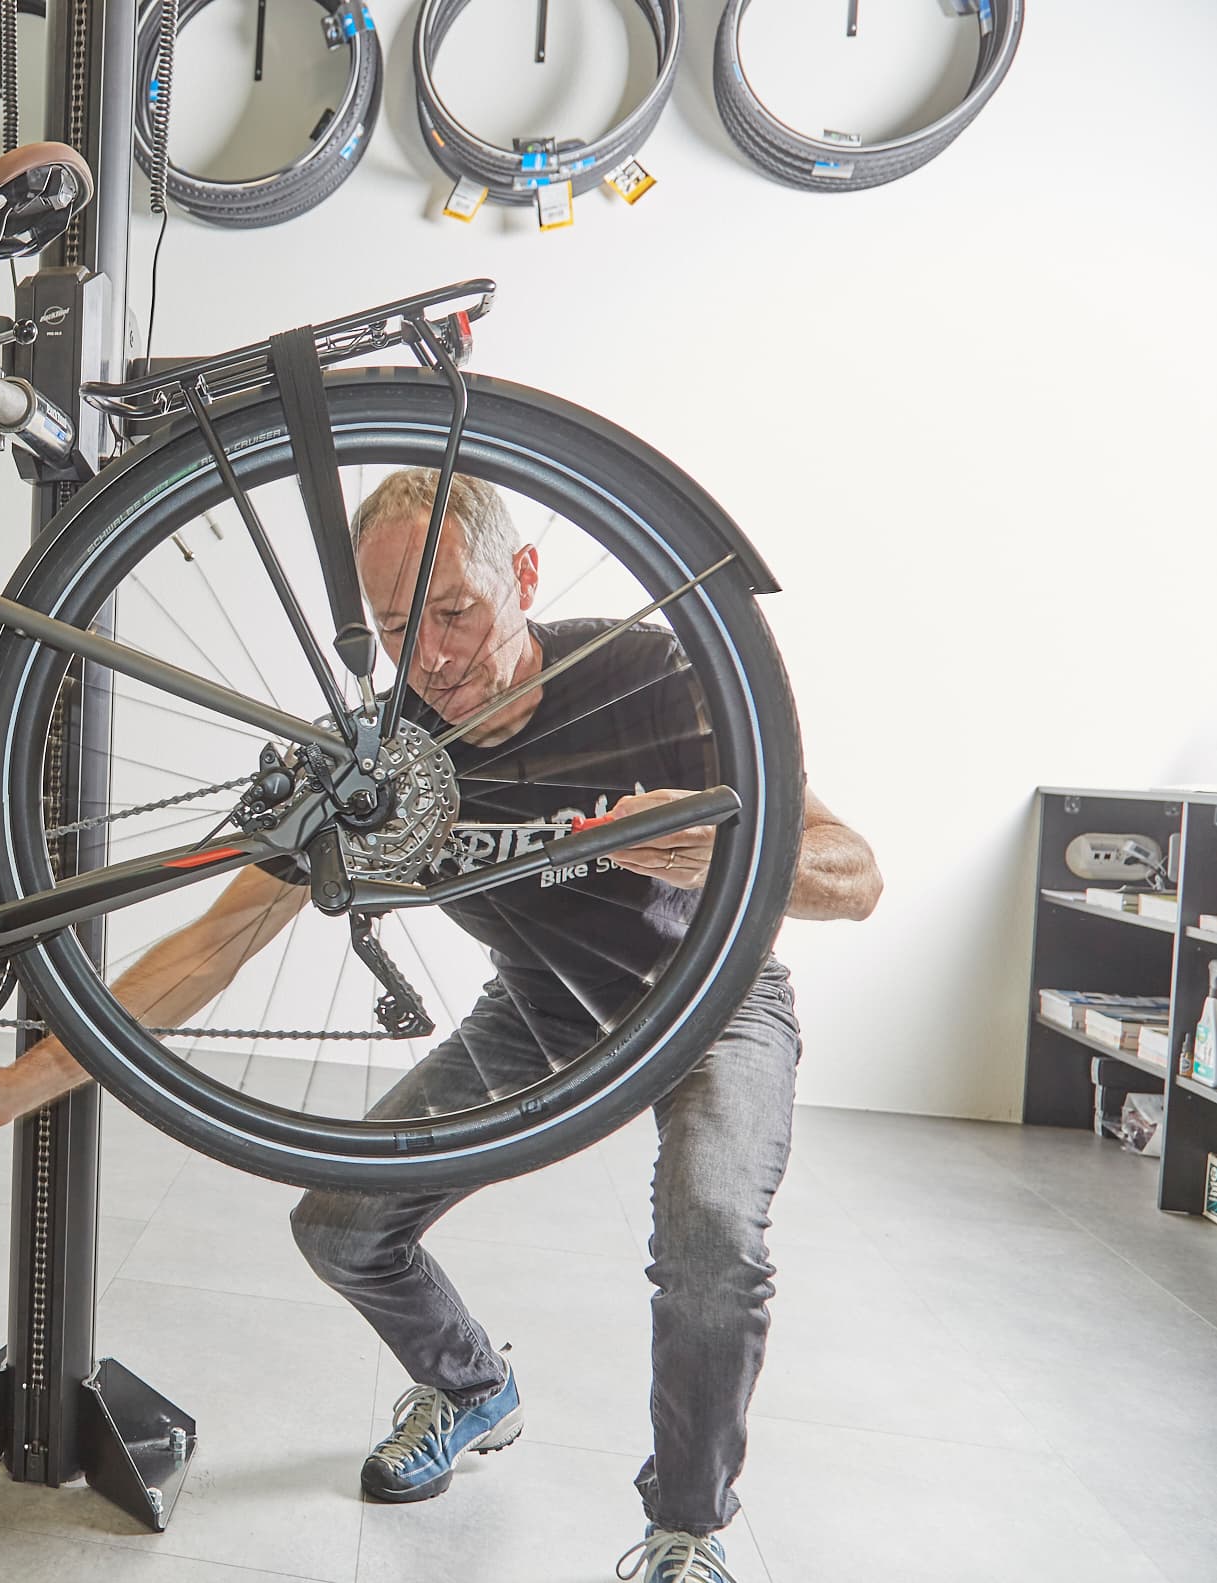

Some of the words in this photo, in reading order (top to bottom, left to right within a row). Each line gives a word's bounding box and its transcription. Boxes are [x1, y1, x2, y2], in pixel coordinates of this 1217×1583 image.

[87, 501, 142, 554] SCHWALBE
[234, 429, 282, 451] CRUISER
[540, 863, 588, 888] Bike
